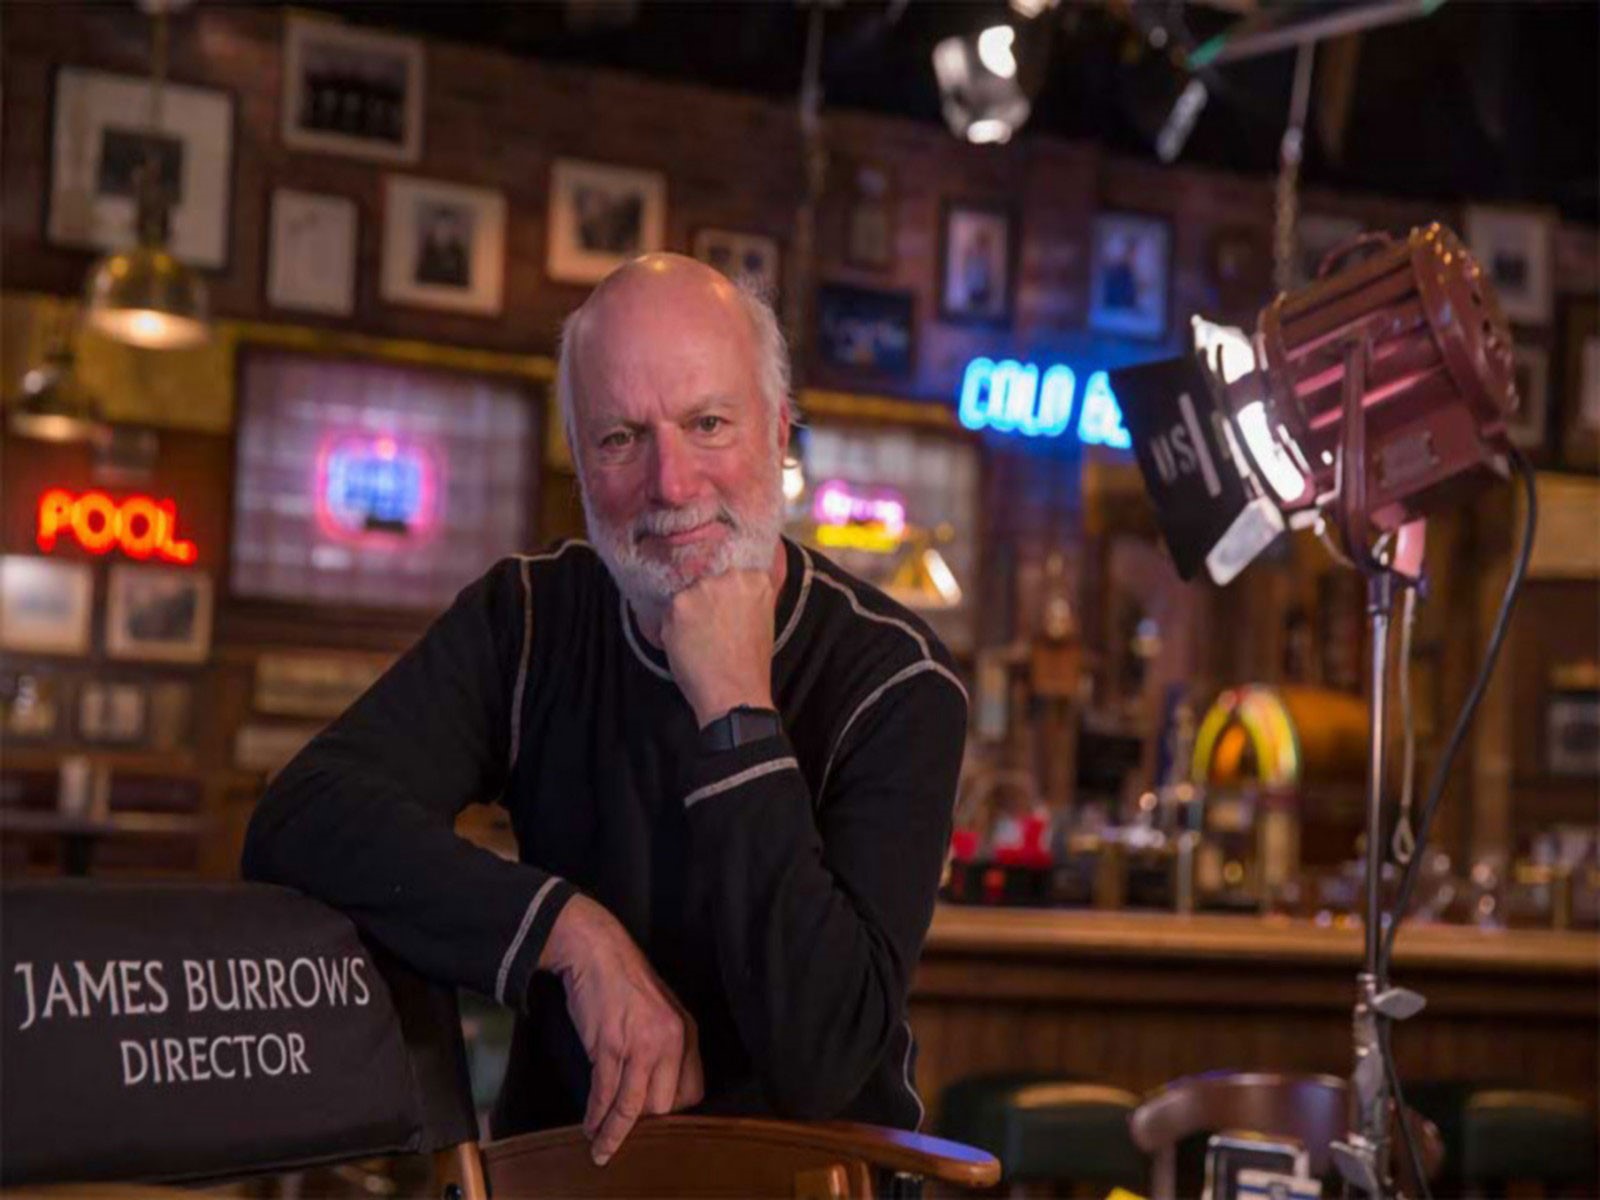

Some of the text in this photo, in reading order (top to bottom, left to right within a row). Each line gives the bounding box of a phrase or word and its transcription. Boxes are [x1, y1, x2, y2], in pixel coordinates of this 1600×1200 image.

[958, 356, 1076, 438] COLD
[37, 487, 198, 565] POOL
[14, 956, 370, 1030] JAMES BURROWS
[120, 1032, 311, 1085] DIRECTOR
